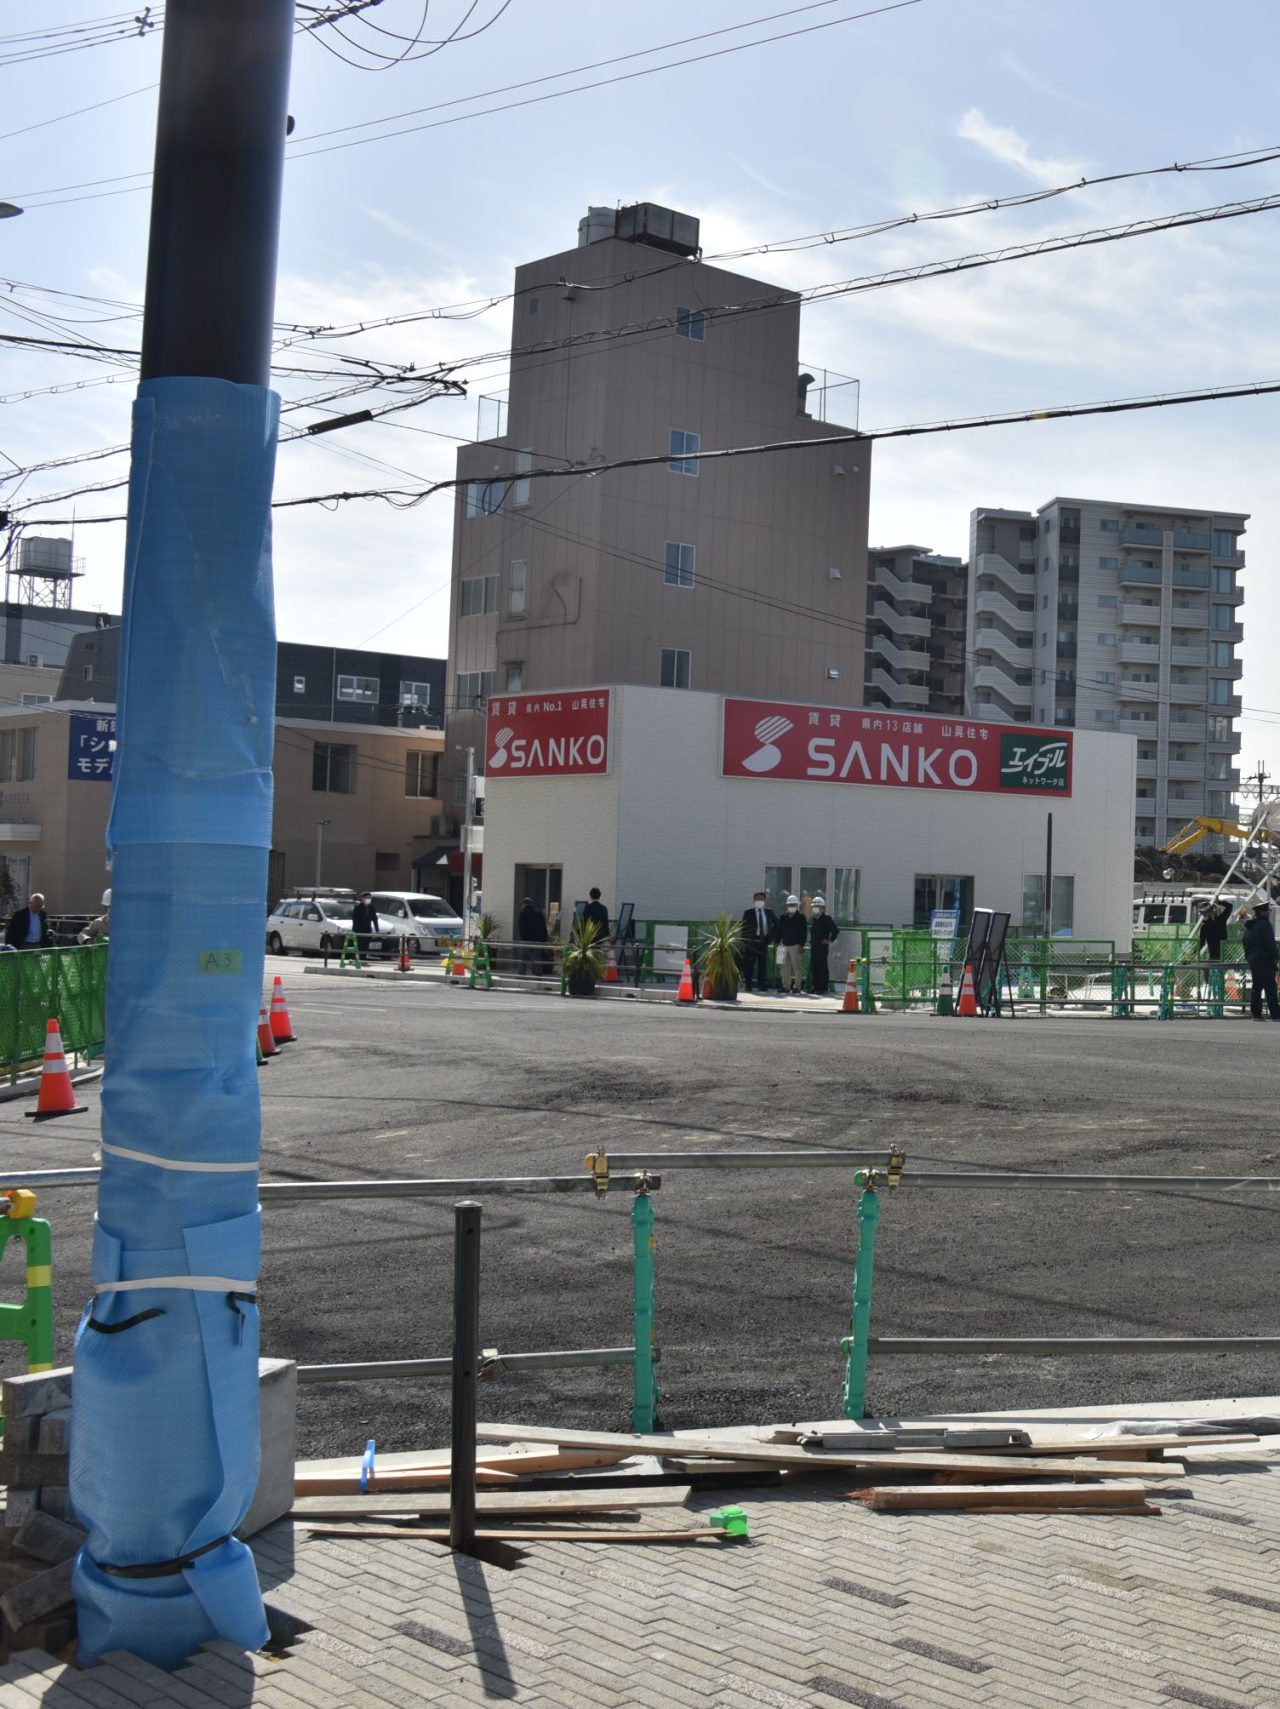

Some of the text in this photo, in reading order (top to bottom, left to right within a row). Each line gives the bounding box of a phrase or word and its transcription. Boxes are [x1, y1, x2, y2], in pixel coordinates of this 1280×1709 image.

[808, 711, 841, 728] 賃貸
[941, 724, 989, 740] 山晃住宅
[77, 757, 113, 773] モデ
[510, 734, 605, 768] SANKO
[807, 737, 978, 787] SANKO
[1001, 742, 1068, 775] エイブル
[1021, 775, 1065, 787] ネットワーク店
